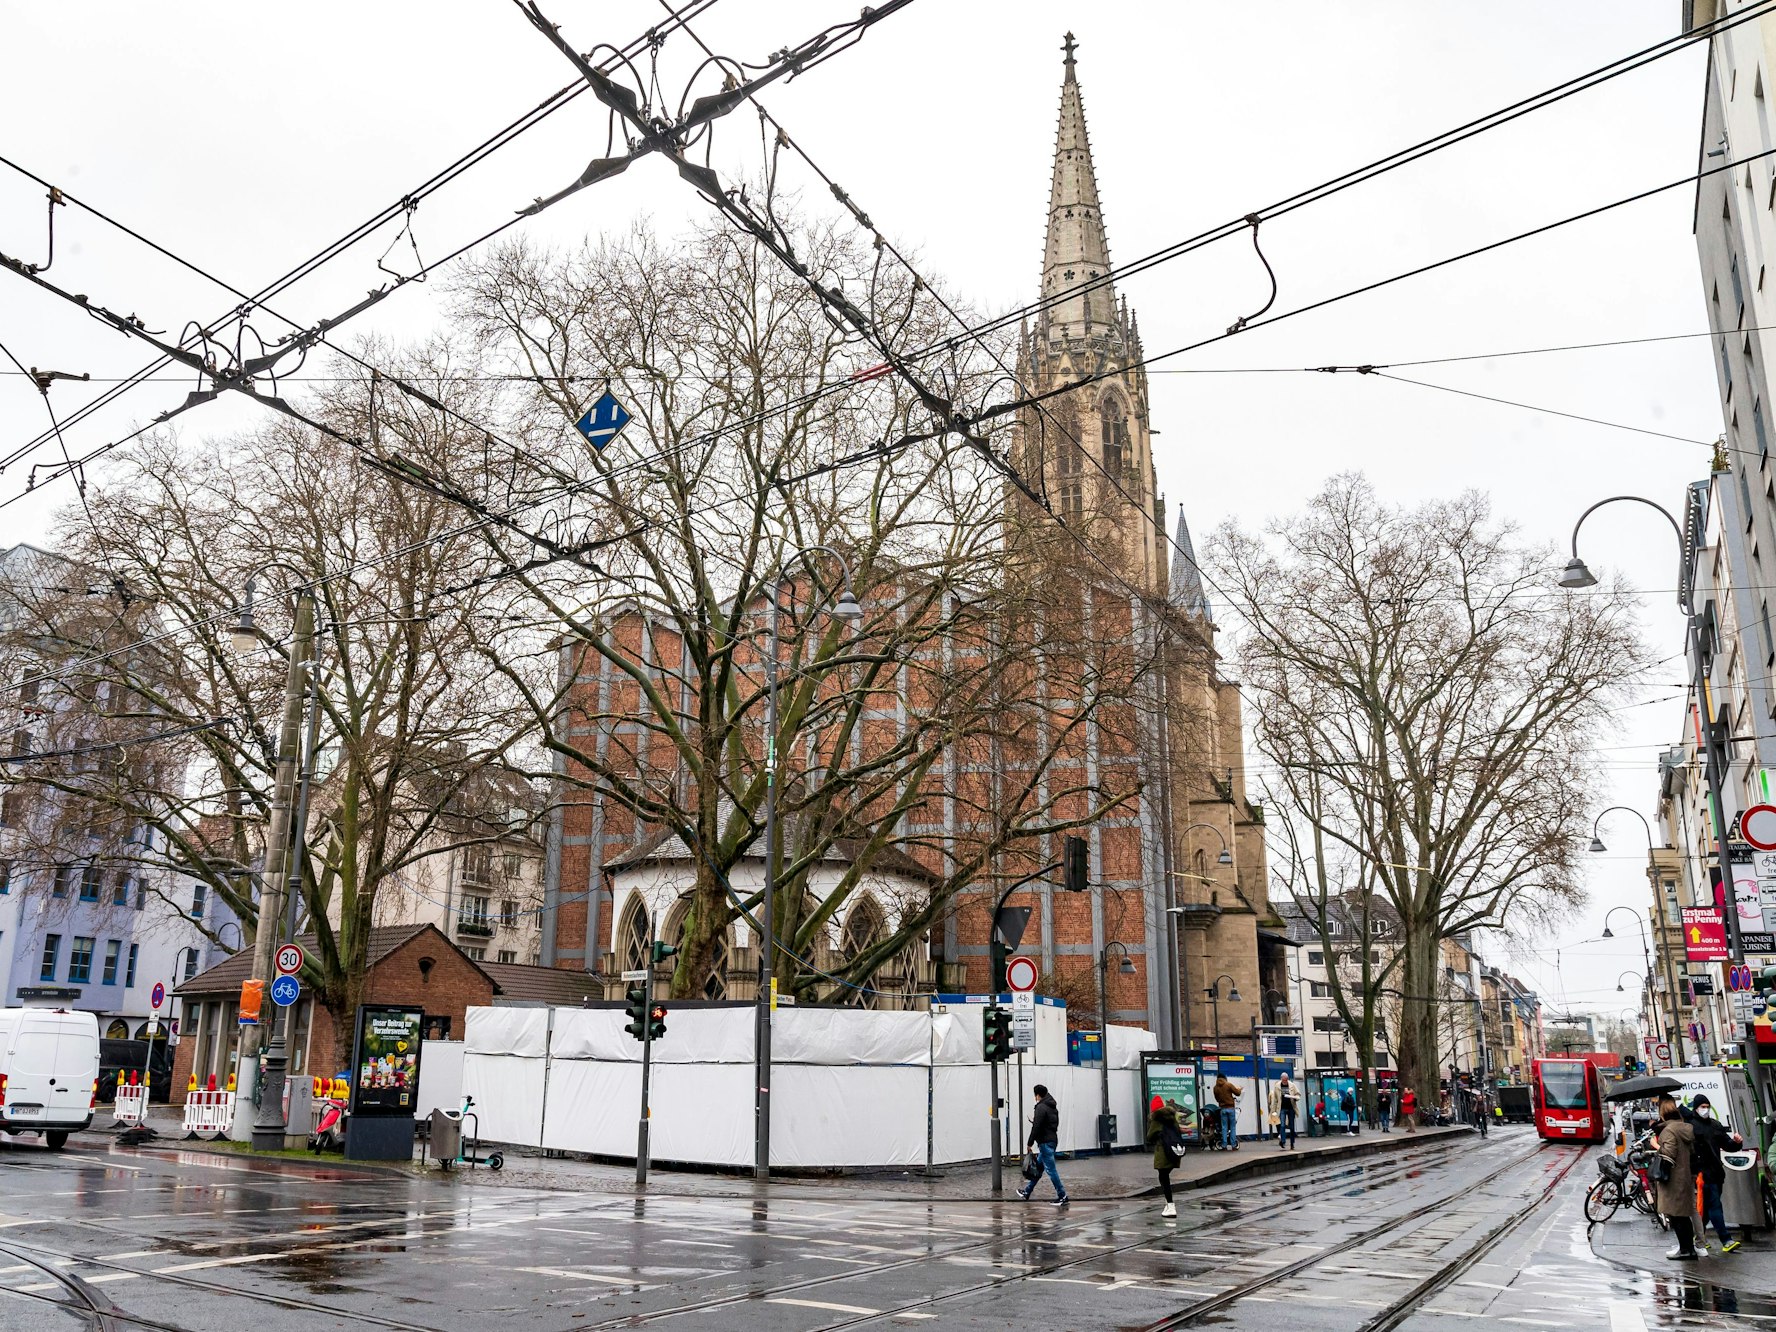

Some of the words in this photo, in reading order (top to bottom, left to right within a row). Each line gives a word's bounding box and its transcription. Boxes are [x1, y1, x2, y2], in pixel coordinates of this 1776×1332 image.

[1681, 908, 1715, 917] Erstmal
[1695, 916, 1723, 924] Penny
[281, 953, 297, 966] 30
[387, 1019, 404, 1028] Beitrag
